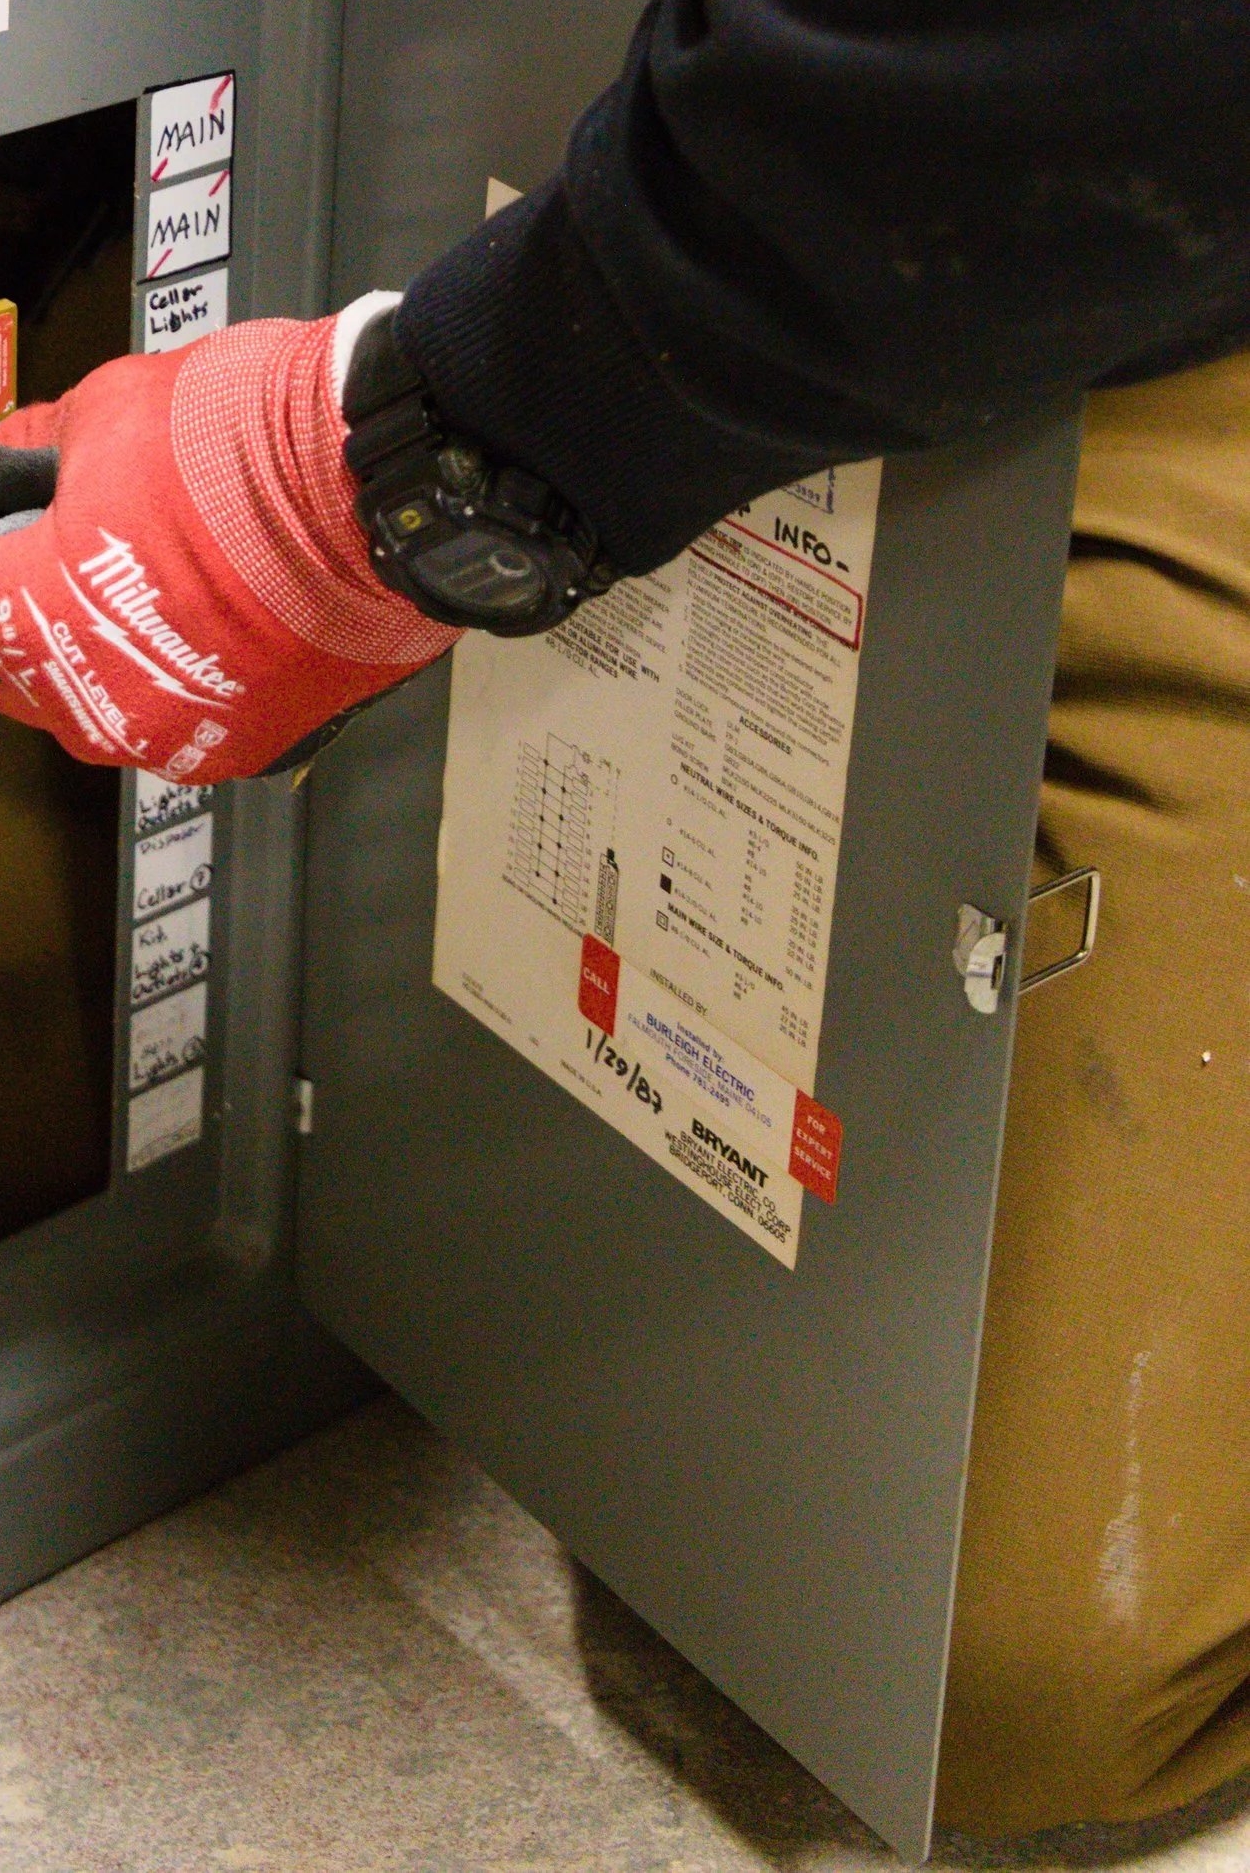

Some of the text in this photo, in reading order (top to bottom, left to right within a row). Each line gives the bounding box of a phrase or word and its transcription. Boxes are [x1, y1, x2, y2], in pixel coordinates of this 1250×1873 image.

[157, 108, 225, 157] MAIN
[151, 202, 220, 248] MAIN
[78, 526, 237, 697] Milwaukee
[20, 669, 36, 686] L
[604, 639, 619, 657] FOR
[622, 651, 636, 669] USE
[640, 664, 659, 684] WITH
[53, 621, 149, 752] CUT LEVEL 1
[680, 759, 714, 792] NEUTRAL
[714, 783, 734, 805] WIRE
[735, 797, 756, 821] SIZES
[765, 817, 797, 848] TORQUE
[667, 900, 687, 923] MAIN
[688, 915, 706, 937] WIRE
[708, 930, 723, 950] SIZE
[732, 947, 763, 978] TORQUE
[583, 965, 610, 996] CALL
[650, 966, 707, 1018] INSTALLED BY
[646, 1011, 754, 1104] BURLEIGH ELECTRIC
[676, 1020, 709, 1053] Installed
[665, 1051, 690, 1078] Phone
[680, 1130, 715, 1165] BRYANT
[796, 1125, 832, 1162] EXPERT
[807, 1113, 826, 1137] FOR
[664, 1128, 732, 1191] WESTINGHOUSE
[691, 1117, 768, 1191] BRYANT
[794, 1144, 831, 1181] SERVICE
[757, 1213, 785, 1244] 06605
